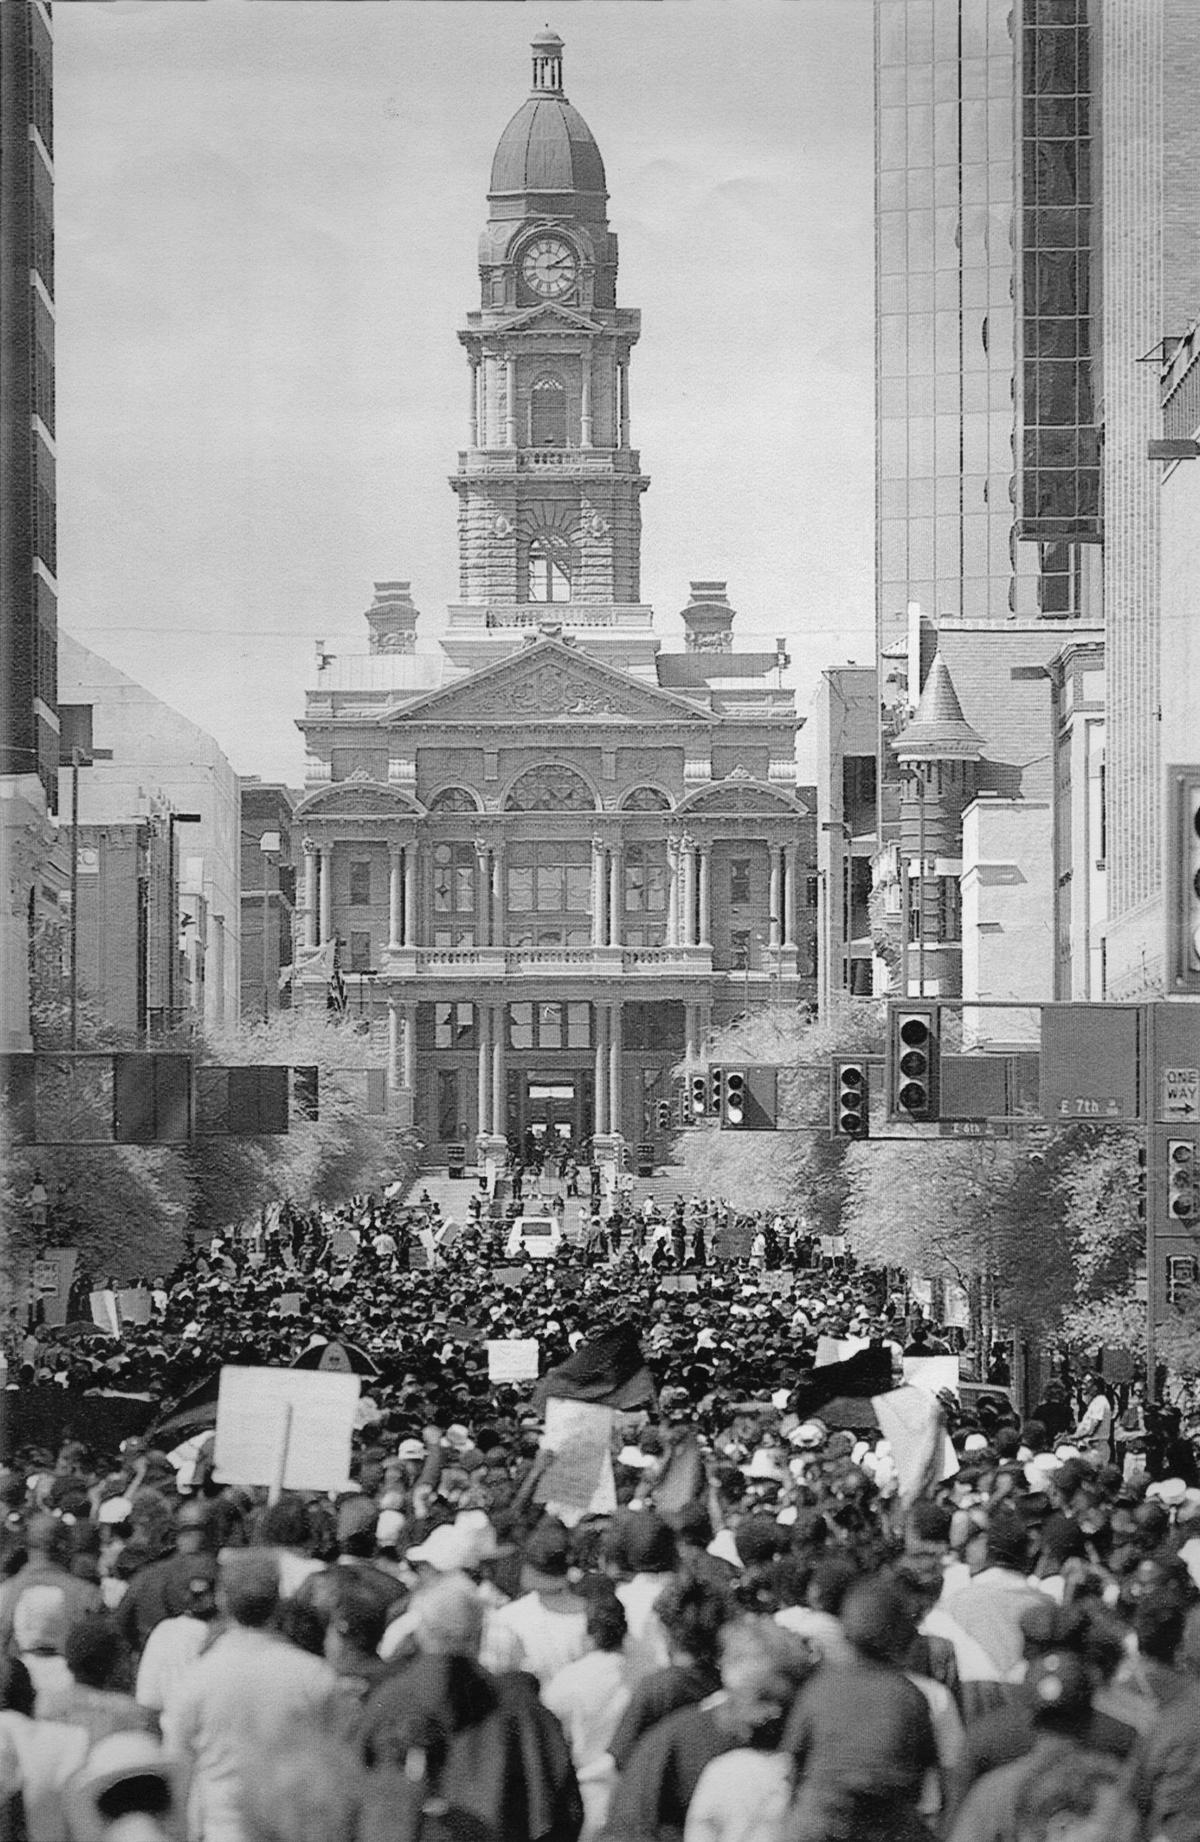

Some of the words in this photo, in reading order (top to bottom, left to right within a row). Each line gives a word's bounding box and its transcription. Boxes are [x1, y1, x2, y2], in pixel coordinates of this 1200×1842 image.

[1166, 1070, 1197, 1084] ONE
[1168, 1087, 1197, 1099] WAY
[1061, 1099, 1069, 1113] E
[1075, 1098, 1099, 1113] 7th
